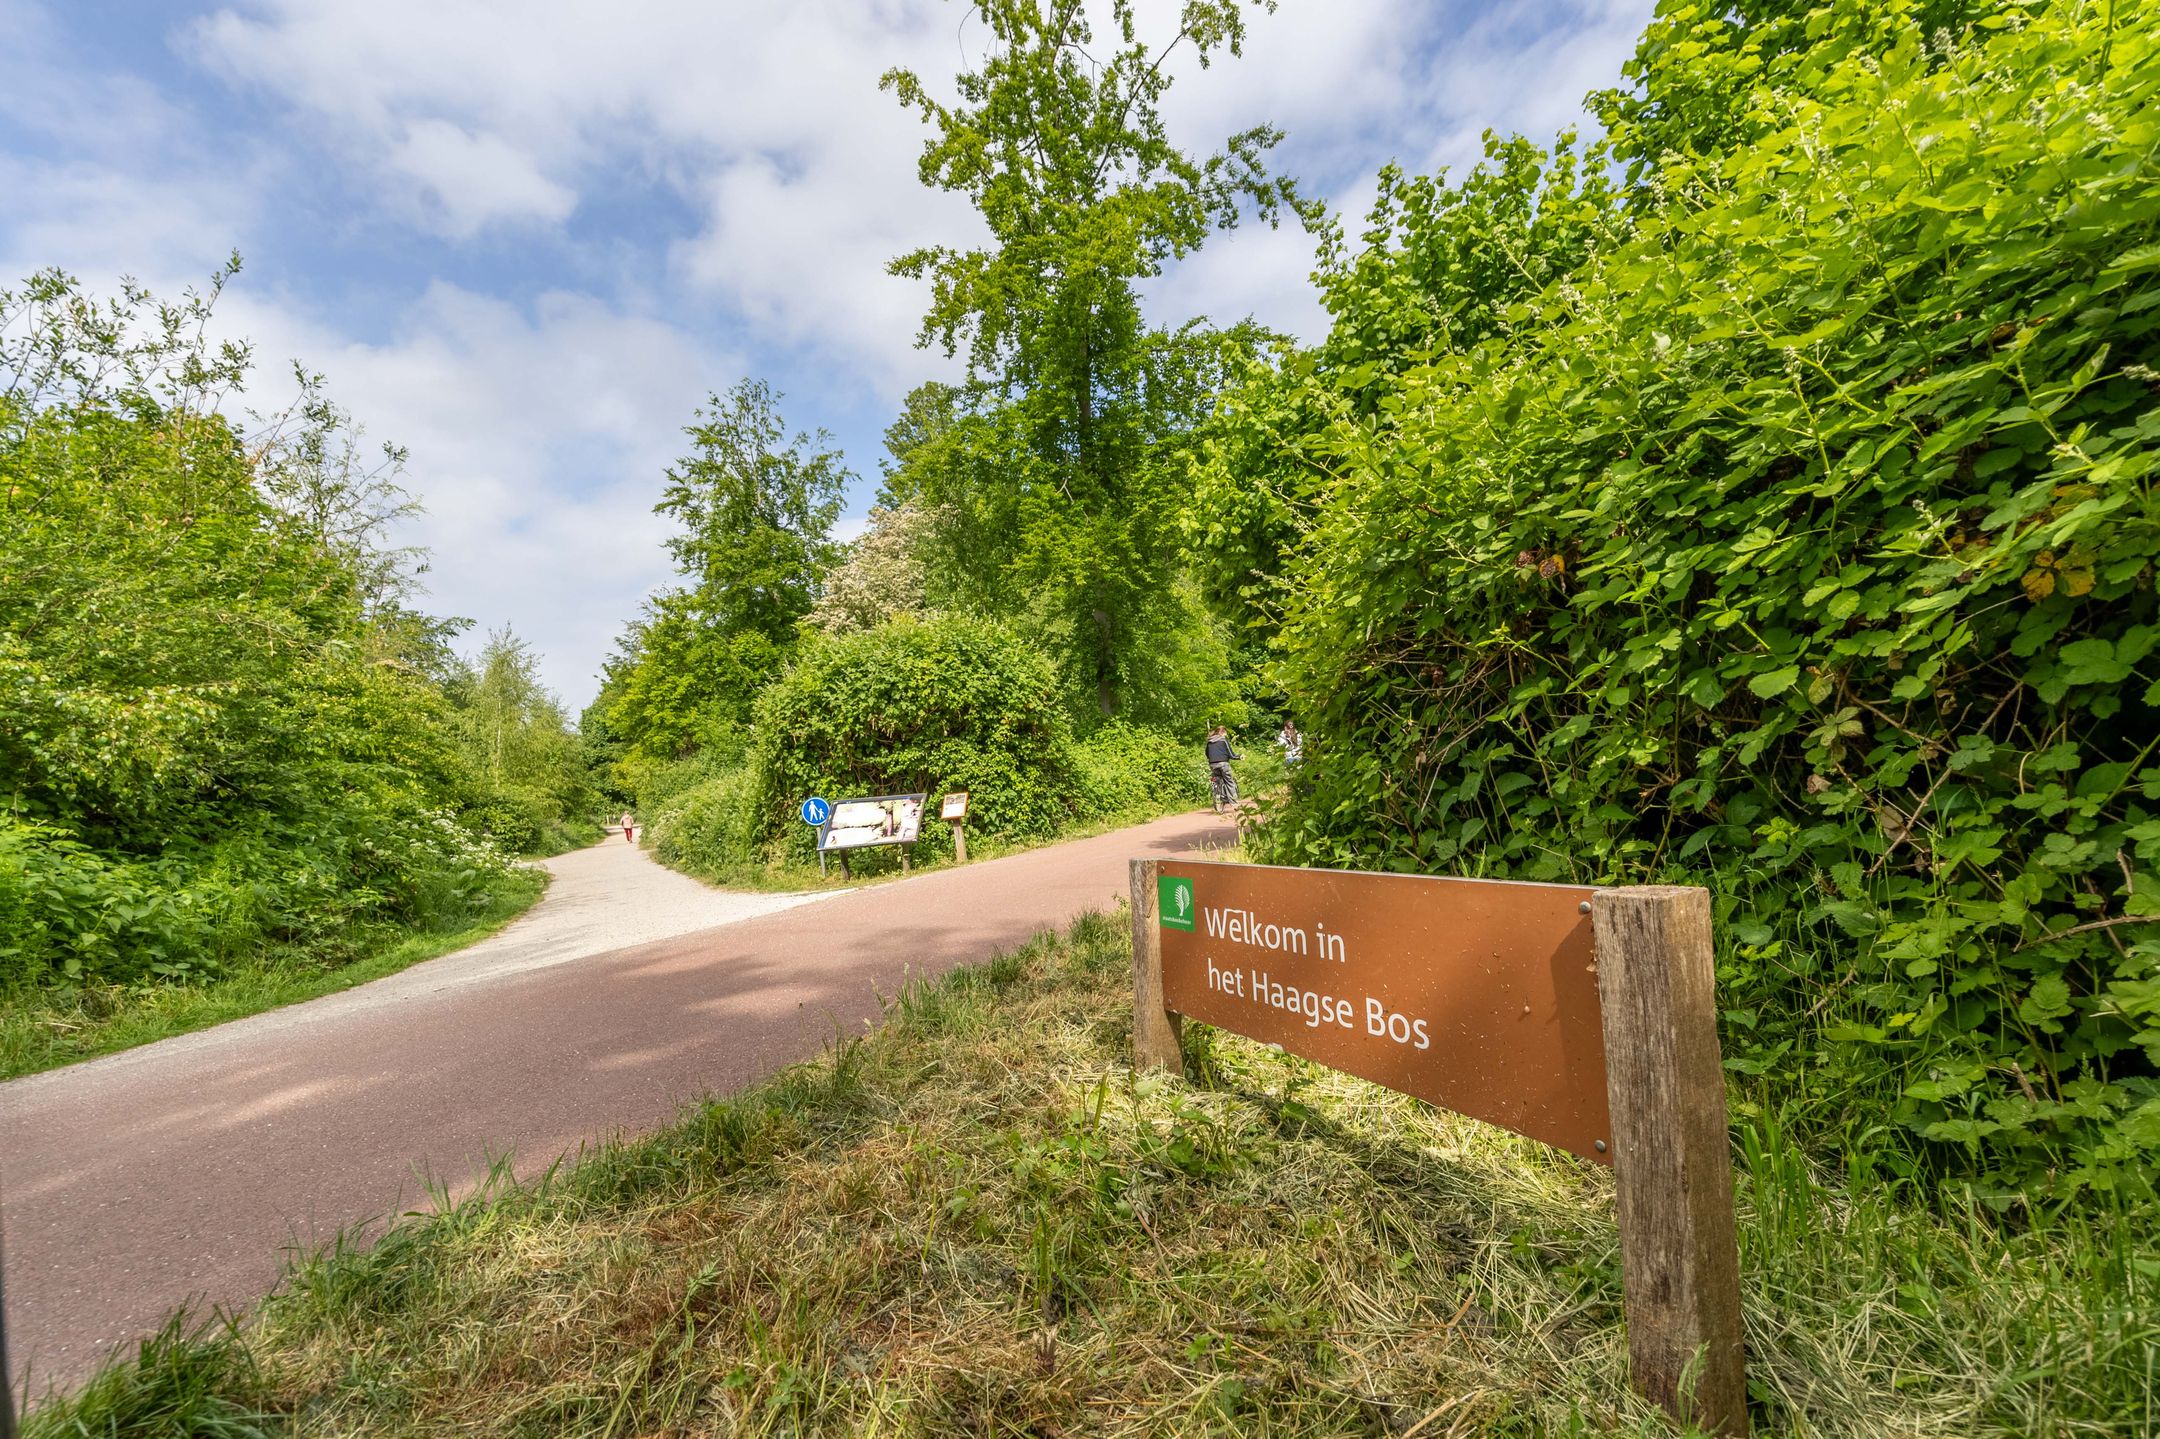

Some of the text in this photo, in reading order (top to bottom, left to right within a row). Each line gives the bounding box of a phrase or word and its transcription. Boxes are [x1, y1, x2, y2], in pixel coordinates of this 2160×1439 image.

[1204, 907, 1345, 963] Welkom in
[1208, 958, 1430, 1050] het Haagse Bos
